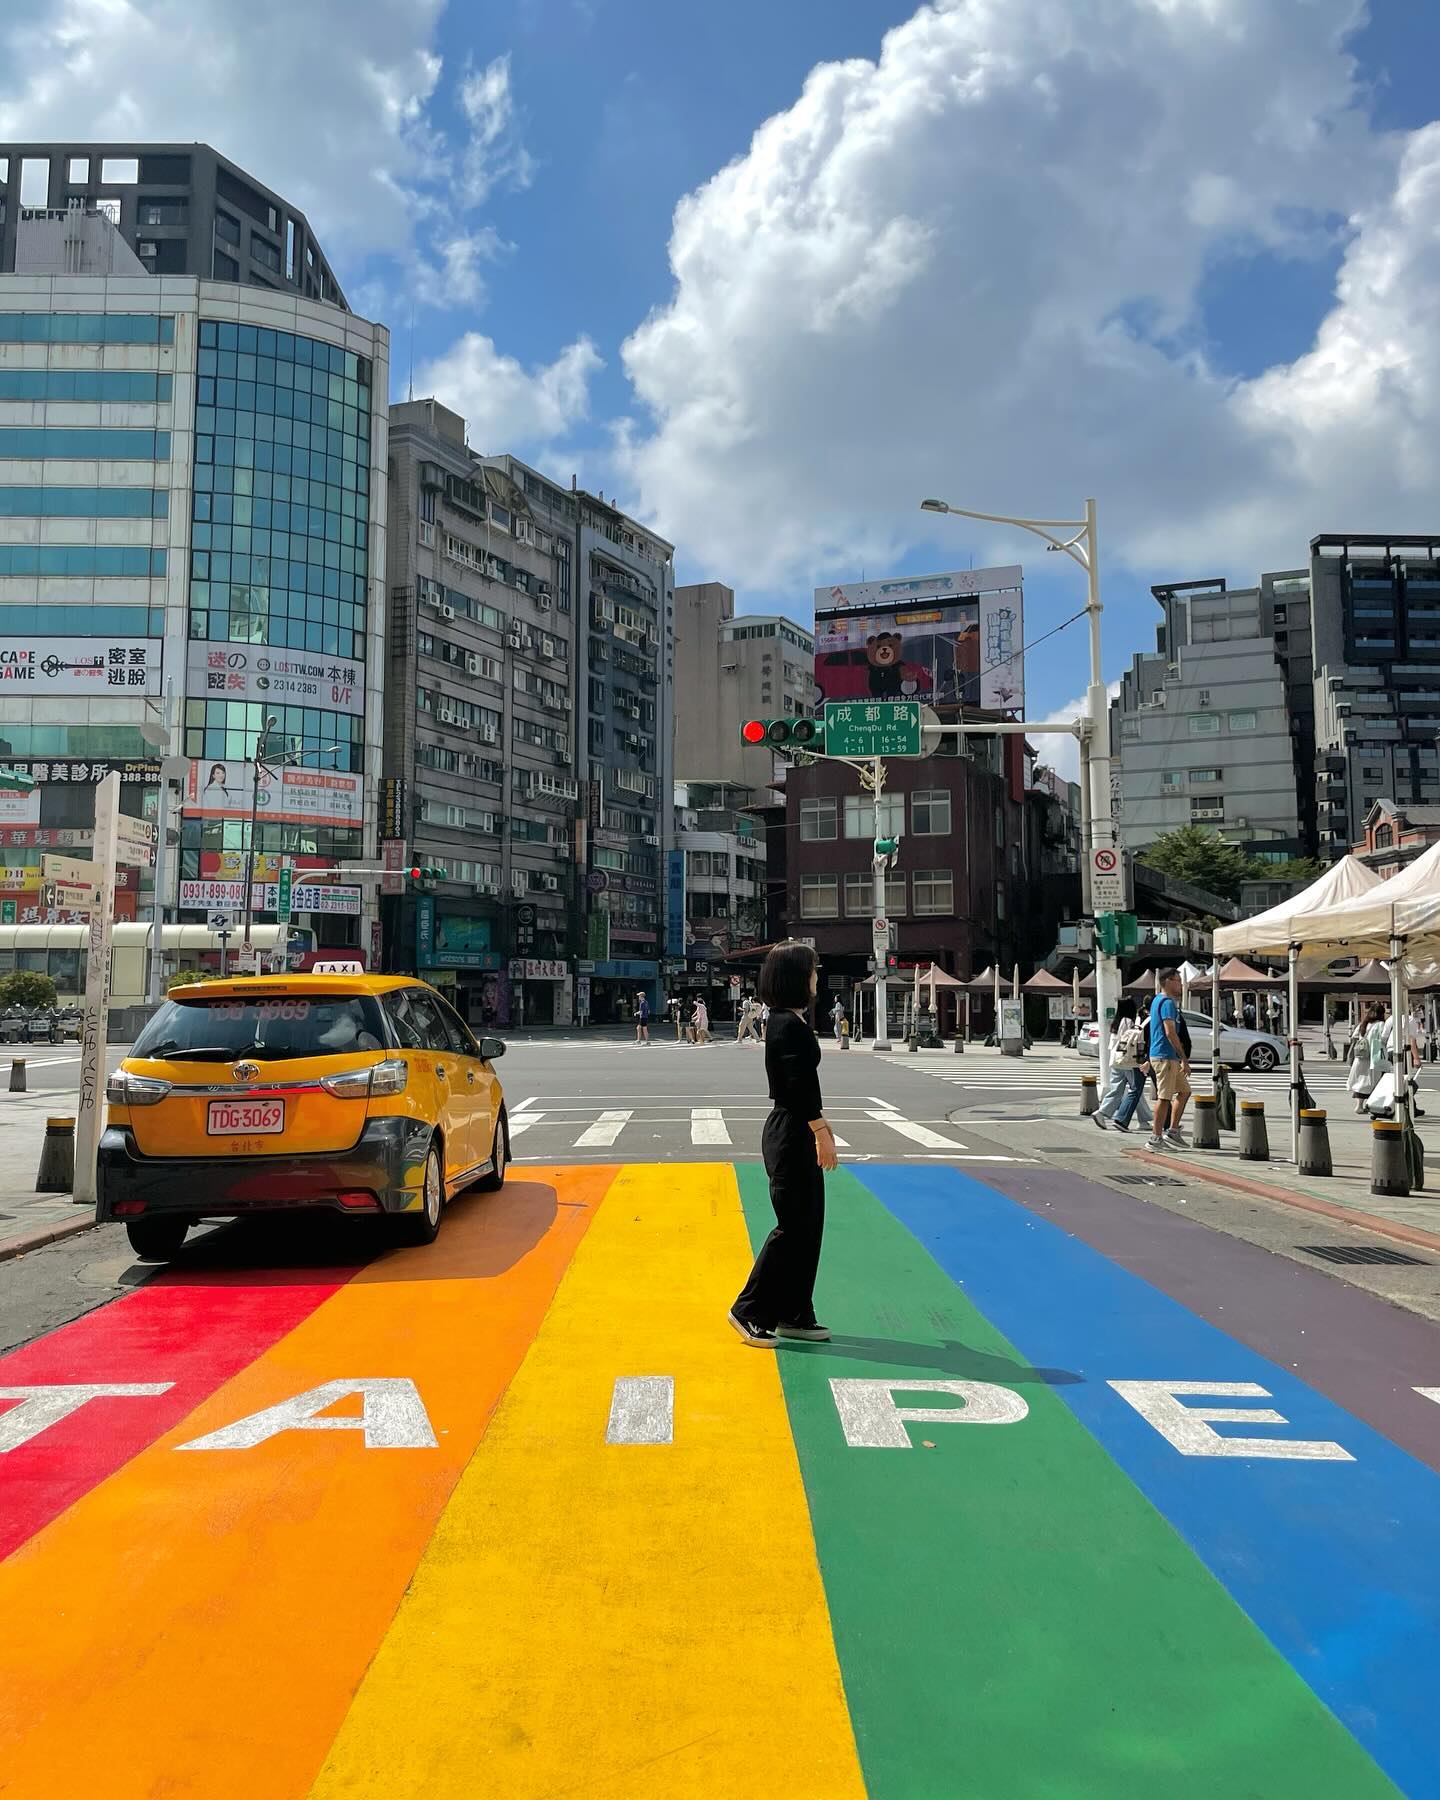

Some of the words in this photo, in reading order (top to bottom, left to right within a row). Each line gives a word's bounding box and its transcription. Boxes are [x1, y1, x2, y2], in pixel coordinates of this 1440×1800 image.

[108, 647, 146, 665] 密室
[107, 668, 146, 685] 逃脫
[274, 659, 325, 679] LOSTTW.COM
[327, 664, 356, 685] 本棟
[273, 679, 295, 692] 2314
[297, 682, 317, 695] 2383
[331, 685, 353, 705] 6/F
[836, 705, 909, 722] 成都路
[848, 723, 882, 734] ChengDu
[319, 964, 357, 973] TAXI
[211, 1108, 281, 1129] TDG-3069
